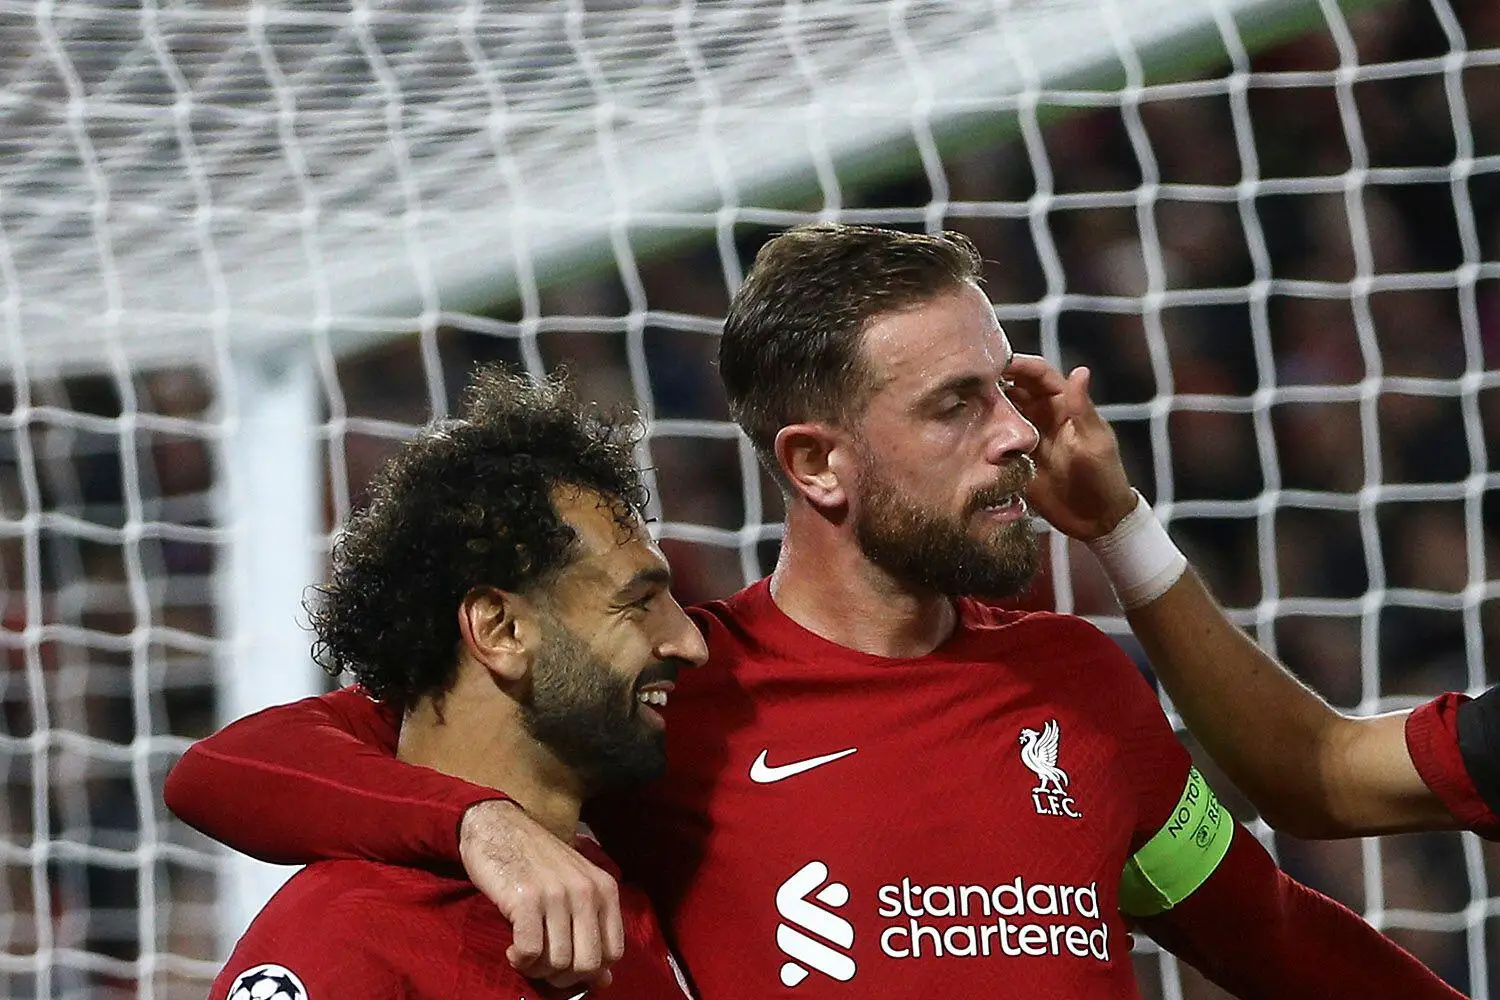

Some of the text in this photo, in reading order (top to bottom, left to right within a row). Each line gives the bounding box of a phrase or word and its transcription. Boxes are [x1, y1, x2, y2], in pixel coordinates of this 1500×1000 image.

[1032, 794, 1082, 817] L.F.C.
[1168, 807, 1190, 838] NO
[1186, 783, 1199, 806] TO
[878, 877, 1099, 919] standard
[880, 917, 1109, 961] chartered
